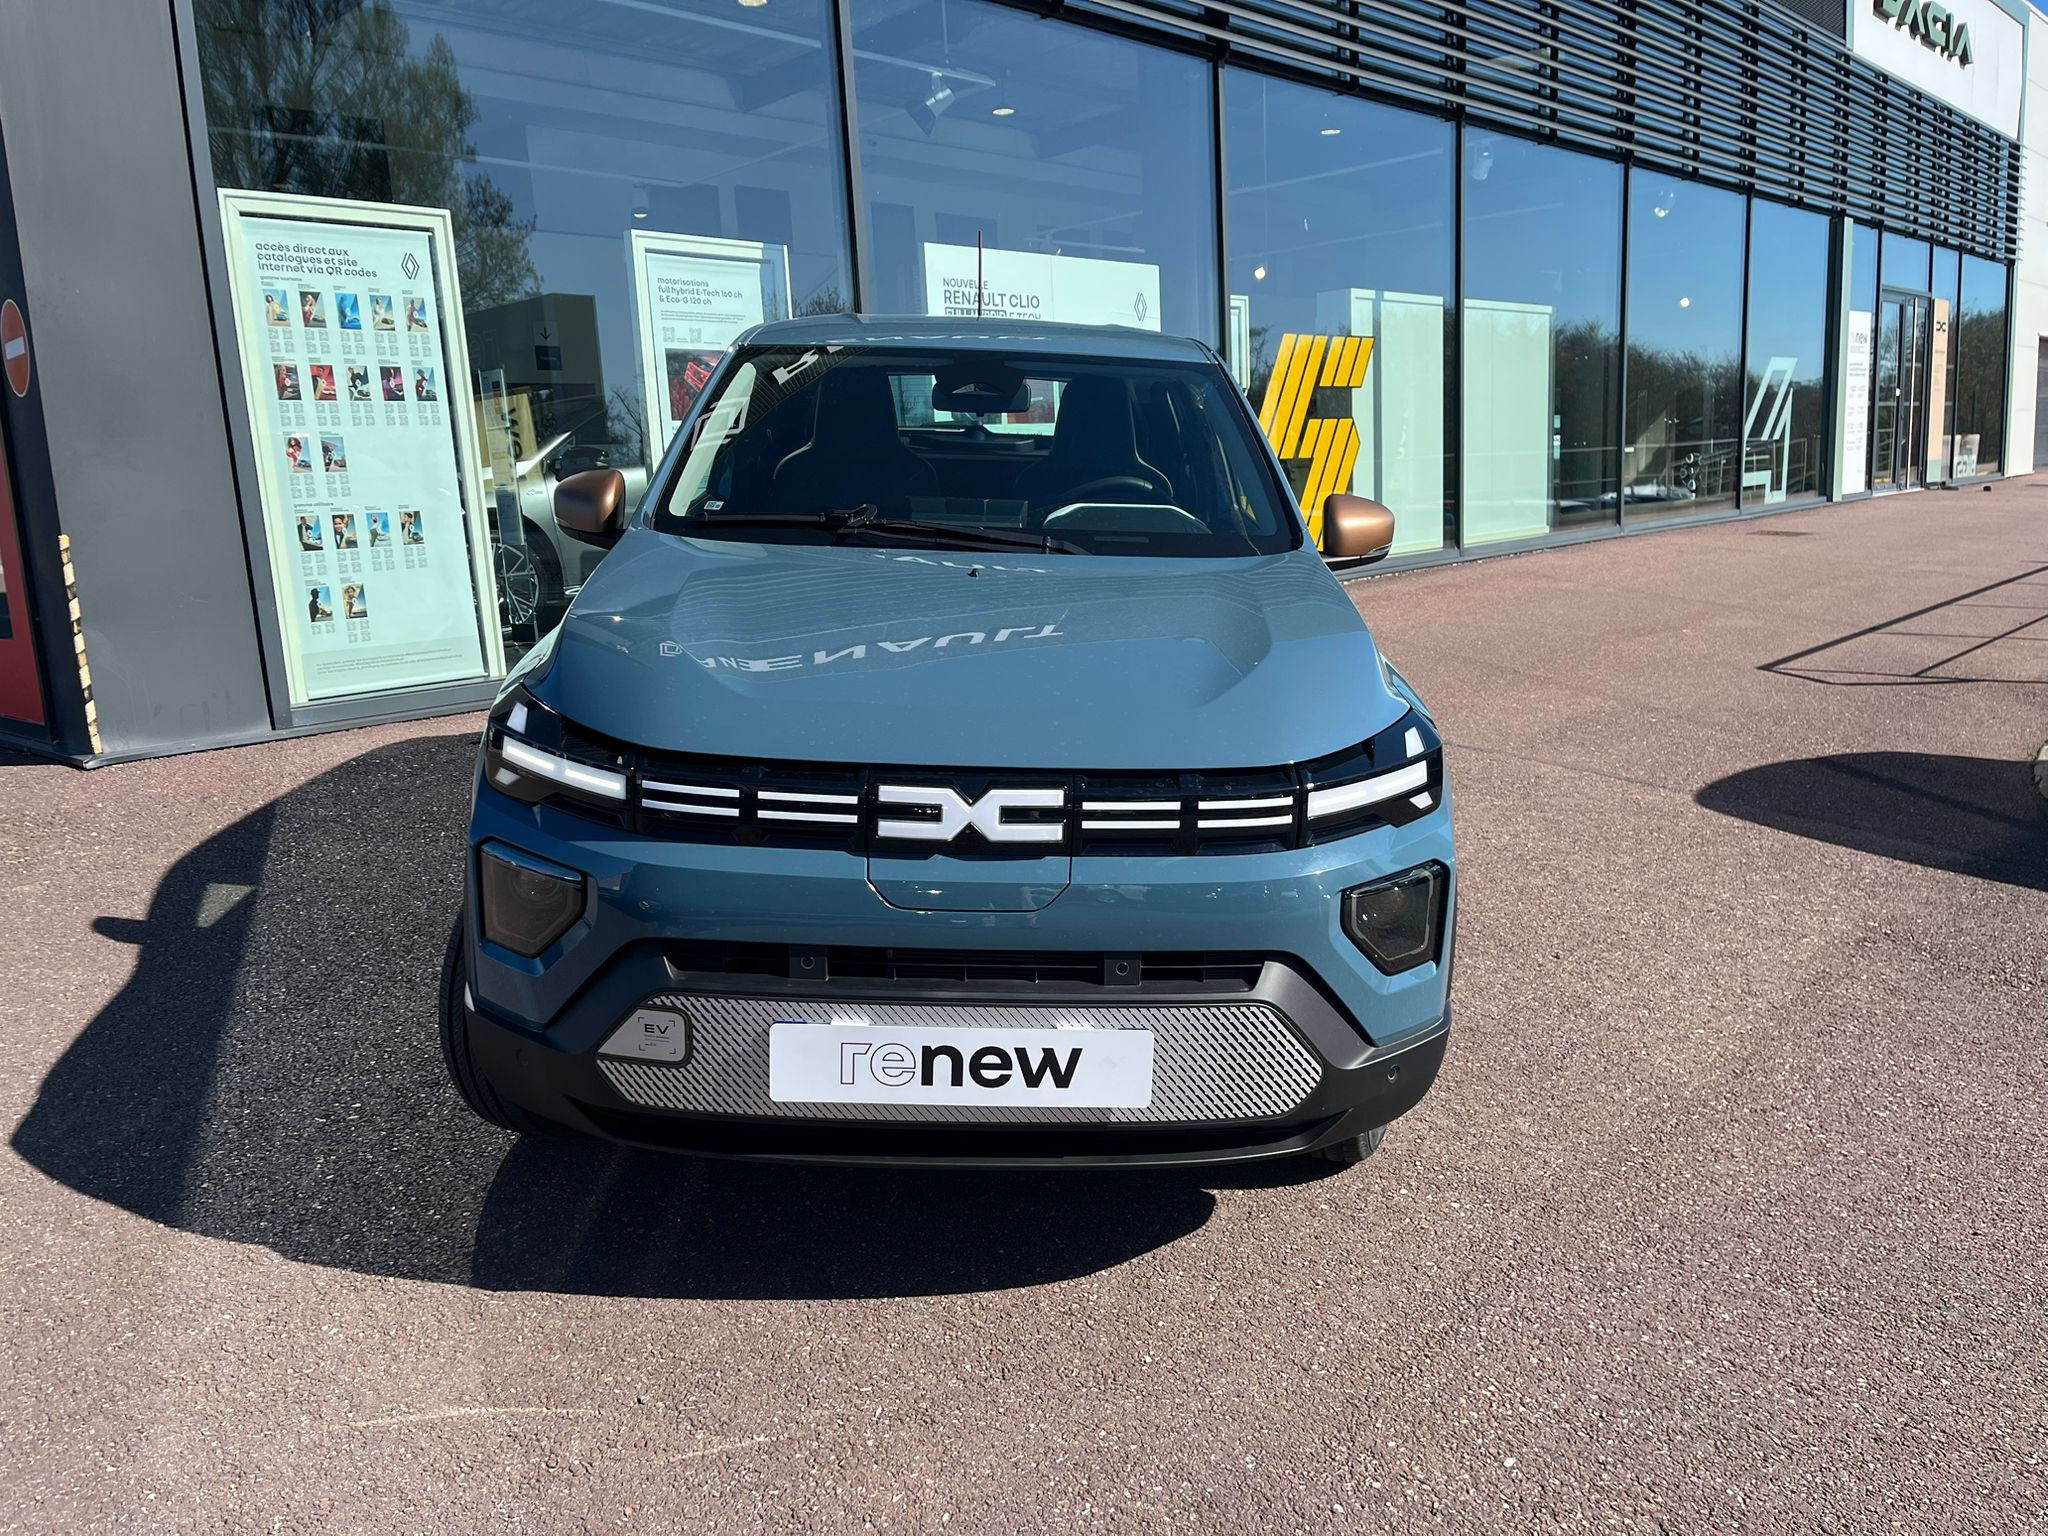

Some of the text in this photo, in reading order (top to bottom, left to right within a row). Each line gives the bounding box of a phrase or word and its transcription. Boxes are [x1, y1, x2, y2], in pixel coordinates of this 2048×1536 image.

[255, 242, 350, 257] accès direct aux
[257, 252, 358, 267] catalogues et site
[257, 261, 378, 278] internet via QR codes
[657, 277, 709, 287] motorisations
[658, 286, 743, 299] full hybrid E-Tech 160 ch
[943, 289, 1040, 309] RENAULT CLIO
[666, 296, 689, 304] Eco-G
[702, 297, 712, 305] ch
[644, 1023, 669, 1034] EV
[840, 1042, 1083, 1089] renew
